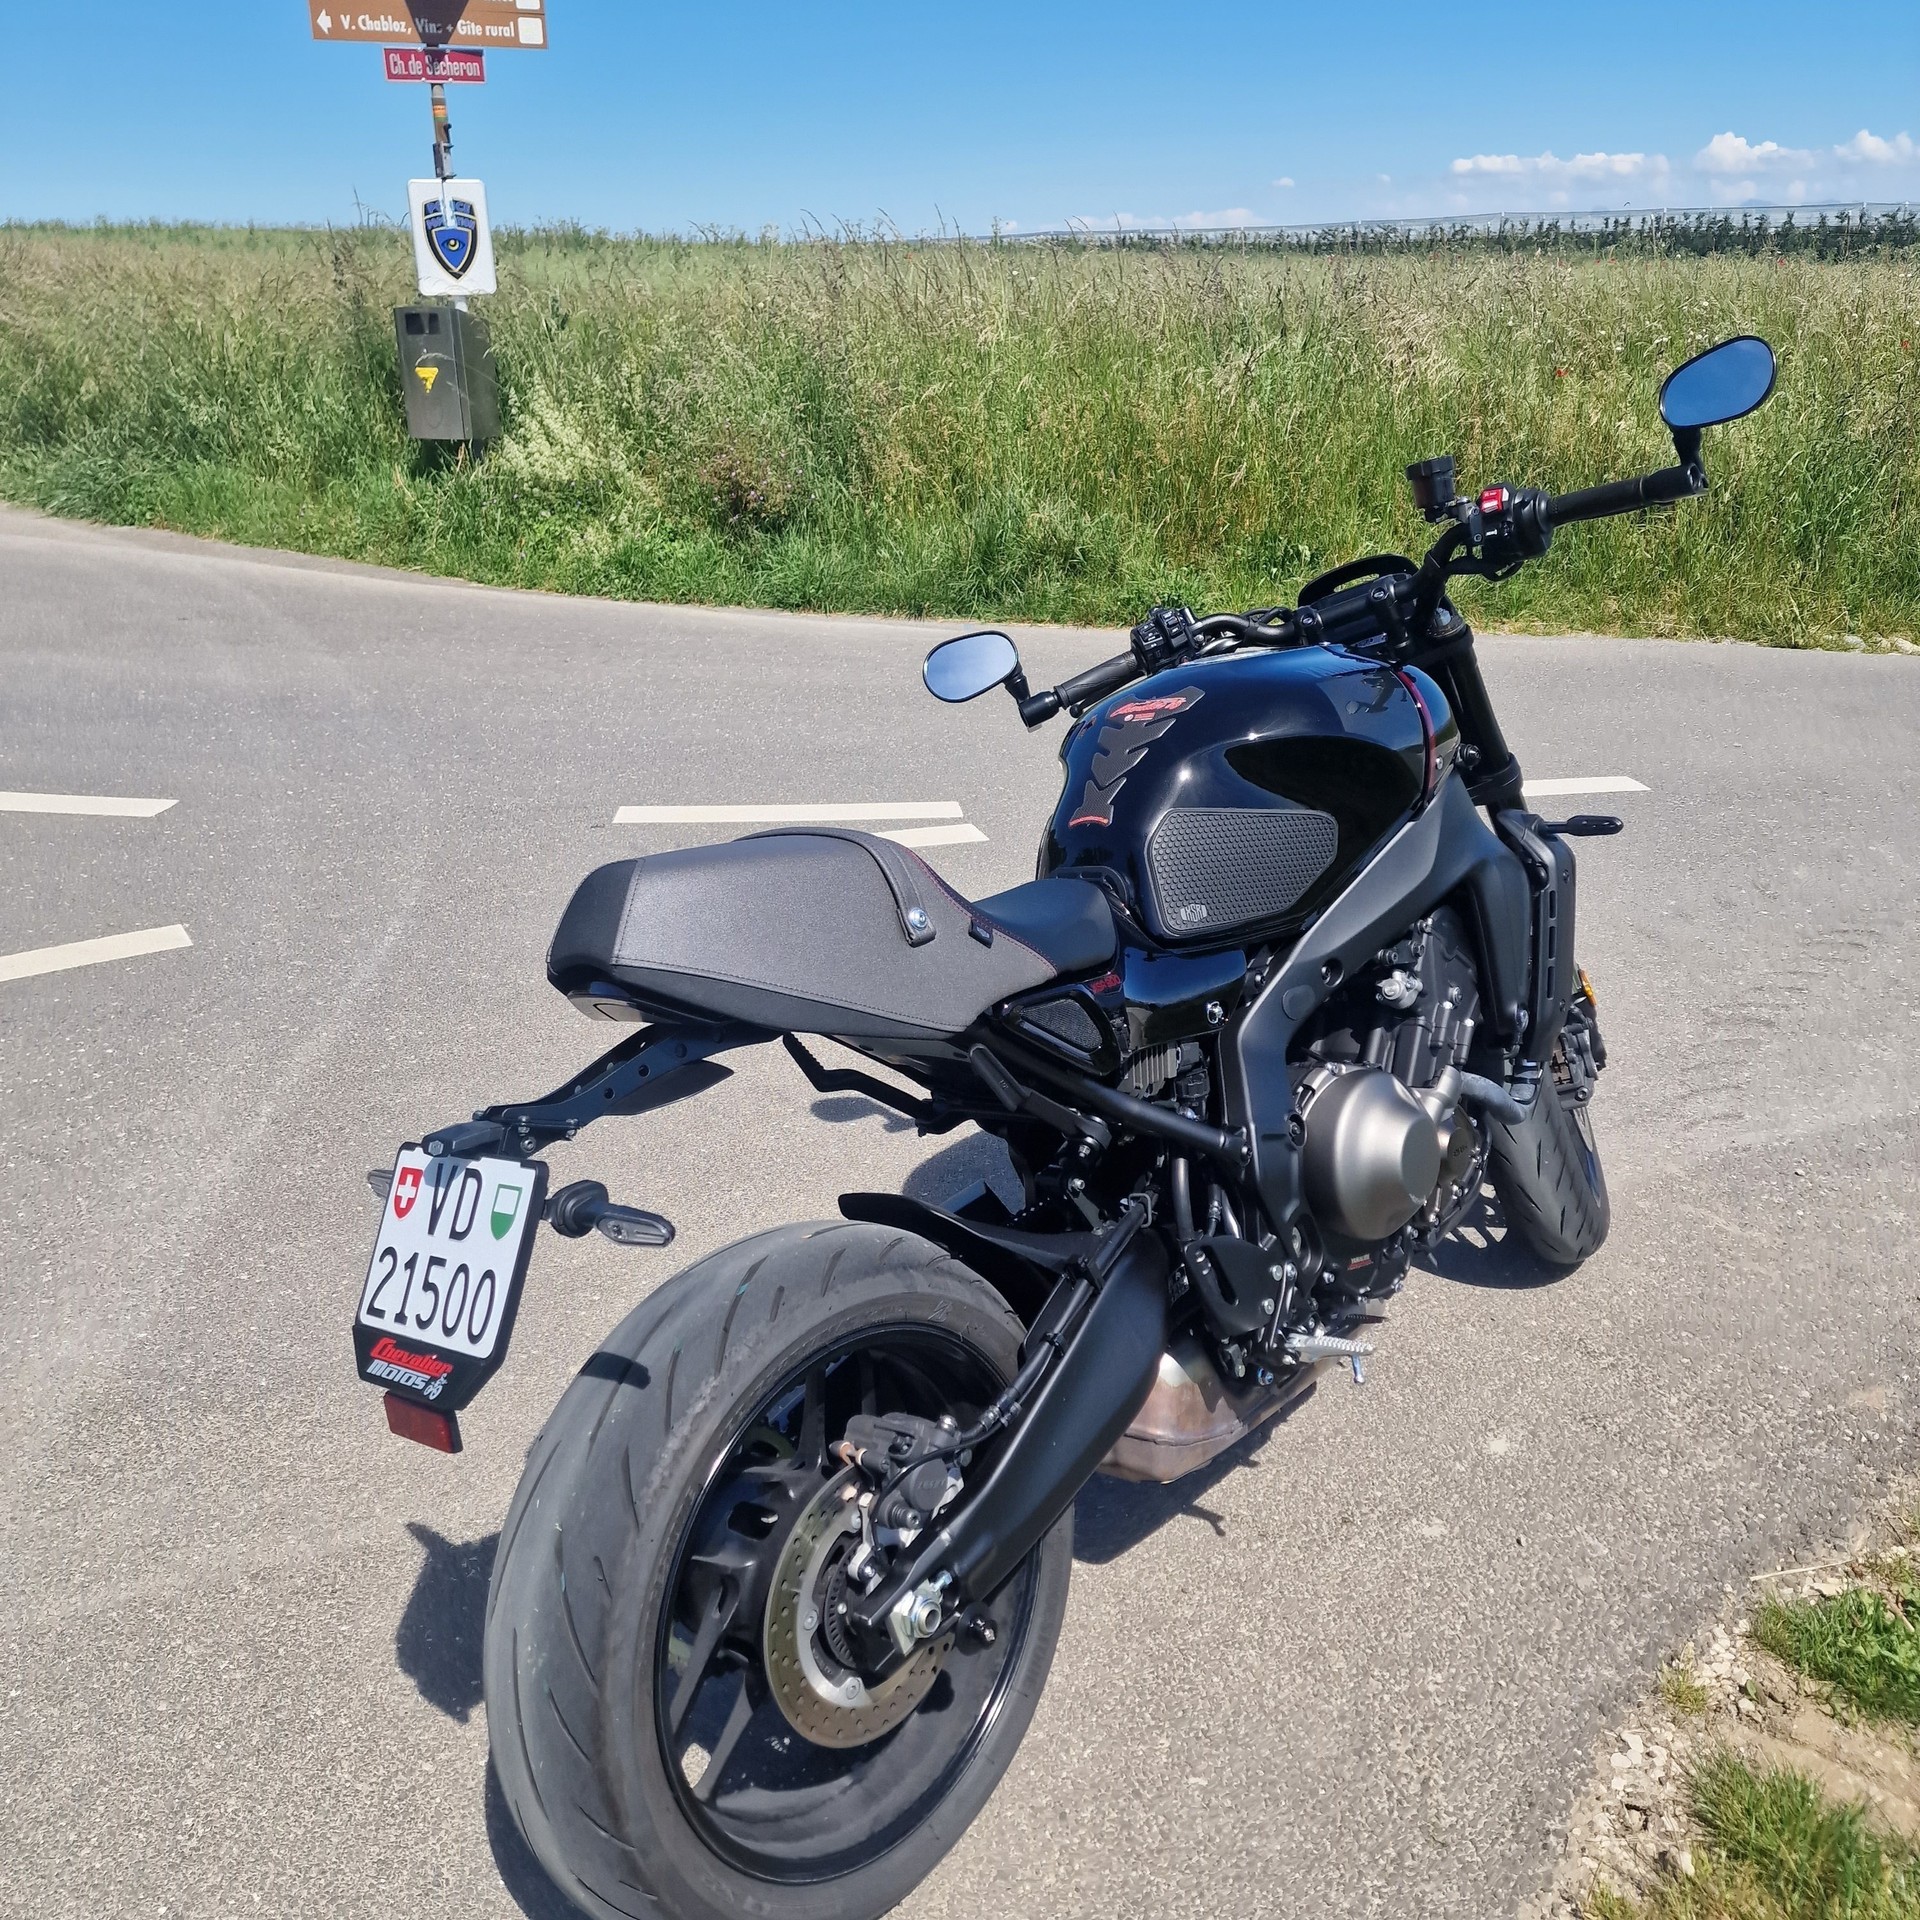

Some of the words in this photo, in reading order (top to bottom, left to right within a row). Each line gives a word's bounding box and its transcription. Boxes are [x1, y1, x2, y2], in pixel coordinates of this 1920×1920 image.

[340, 14, 356, 30] V.
[357, 14, 412, 35] Chabloz,
[485, 21, 515, 38] rural
[389, 53, 409, 75] Ch.
[408, 53, 423, 75] de
[427, 1162, 483, 1241] VD
[366, 1246, 496, 1345] 21500
